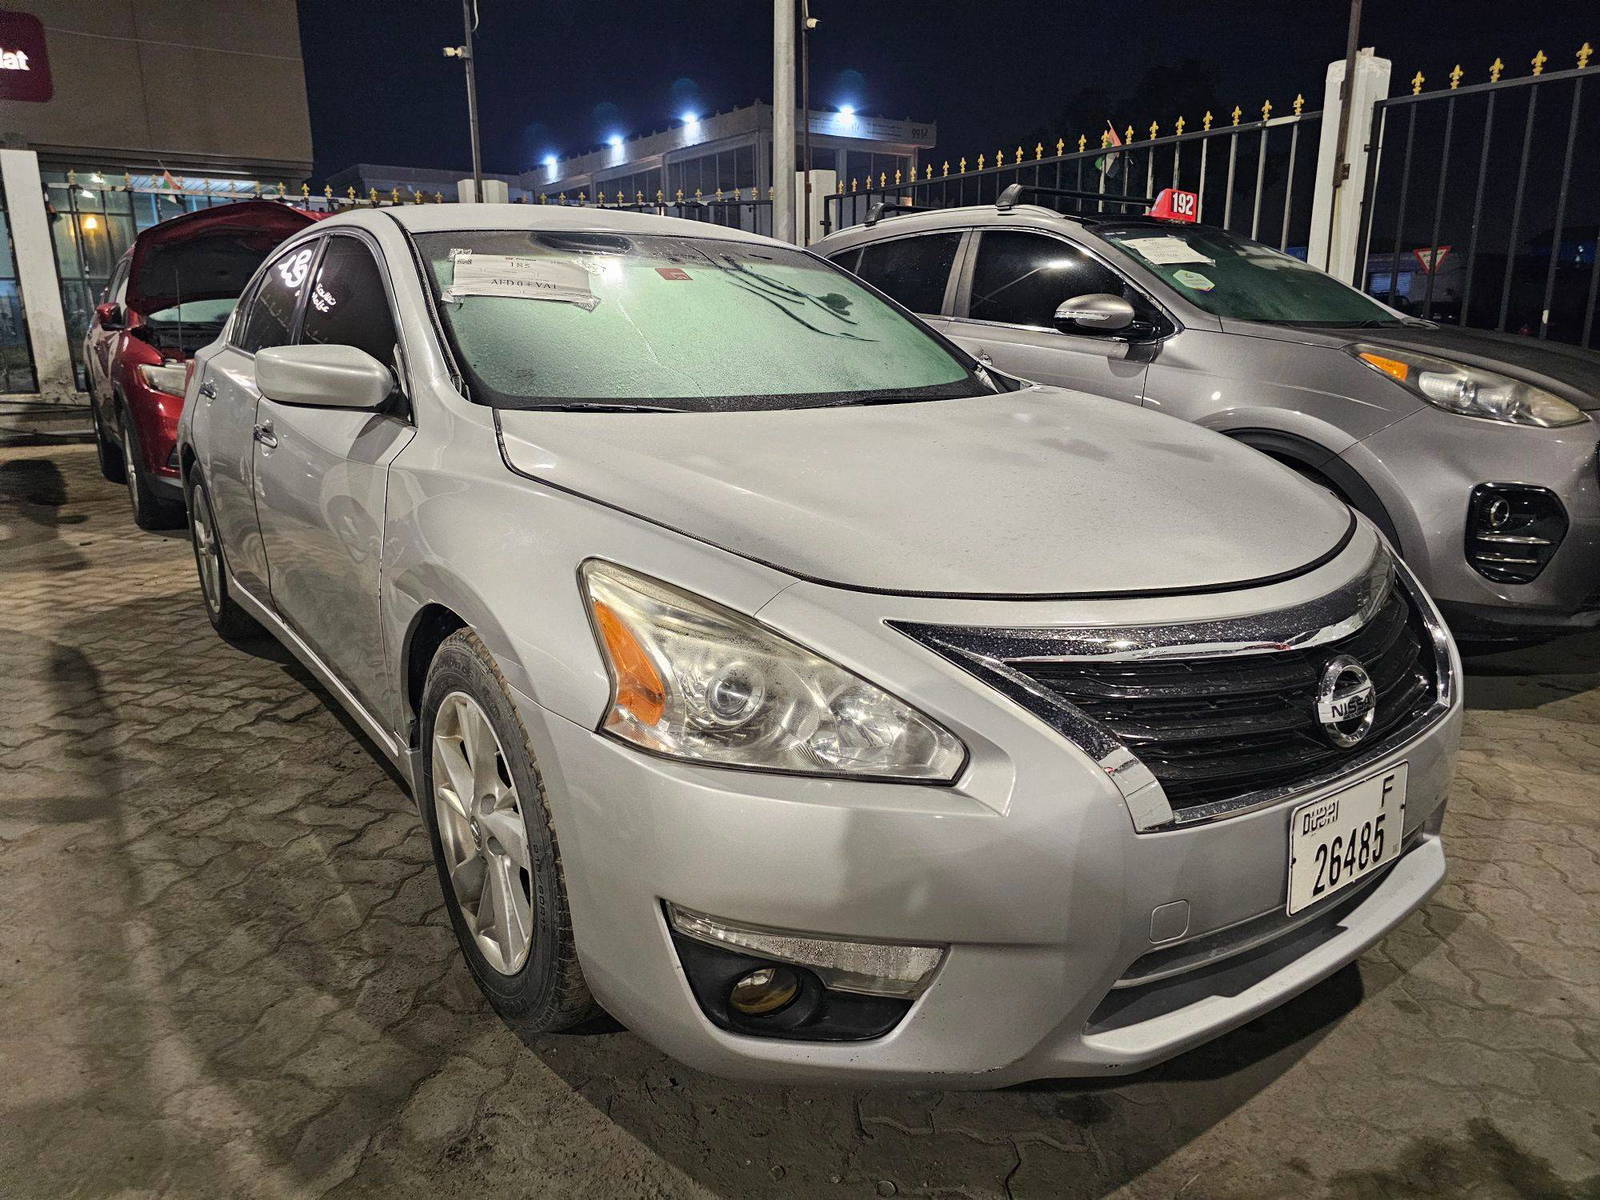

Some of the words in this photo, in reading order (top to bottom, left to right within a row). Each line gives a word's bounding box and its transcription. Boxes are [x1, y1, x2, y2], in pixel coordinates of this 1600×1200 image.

[1172, 192, 1194, 215] 192
[1380, 775, 1395, 808] F
[1312, 814, 1386, 897] 26485
